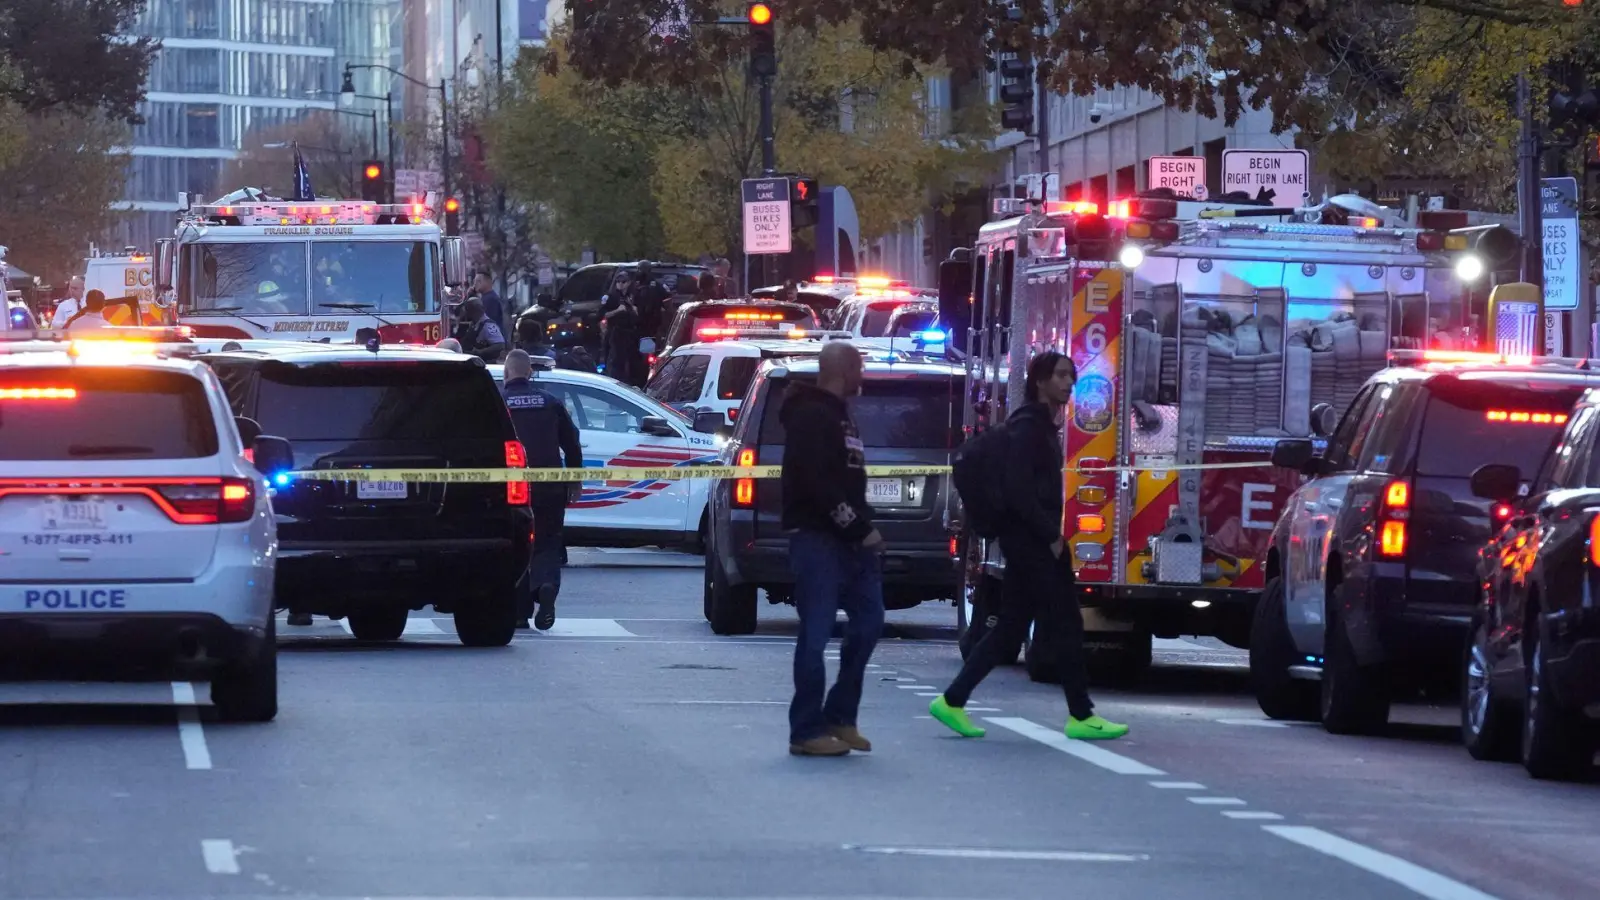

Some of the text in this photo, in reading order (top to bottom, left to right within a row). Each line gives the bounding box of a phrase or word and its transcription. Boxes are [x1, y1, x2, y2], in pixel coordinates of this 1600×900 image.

[1160, 162, 1195, 172] BEGIN
[1250, 158, 1281, 169] BEGIN
[1160, 176, 1195, 187] RIGHT
[1227, 173, 1303, 184] RIGHT TURN LANE
[755, 182, 775, 190] RIGHT
[752, 204, 780, 214] BUSES
[1542, 203, 1559, 213] ANE
[753, 214, 780, 223] BIKES
[263, 227, 354, 235] FRANKLIN SQUARE
[754, 223, 779, 232] ONLY
[1545, 241, 1567, 255] KES
[125, 268, 152, 287] BC
[1086, 282, 1109, 313] E
[1499, 302, 1537, 313] KEEP
[423, 324, 440, 341] 16
[1085, 323, 1107, 354] 6
[506, 398, 545, 406] POLICE
[467, 472, 491, 481] POLICE
[546, 472, 559, 480] NOT
[589, 471, 613, 480] POLICE
[644, 469, 735, 479] POLICE LINE DO NOT CROSS
[873, 484, 899, 496] 81295
[1242, 483, 1276, 529] E
[22, 534, 133, 545] 1-877-4FPS-411
[25, 589, 126, 609] POLICE
